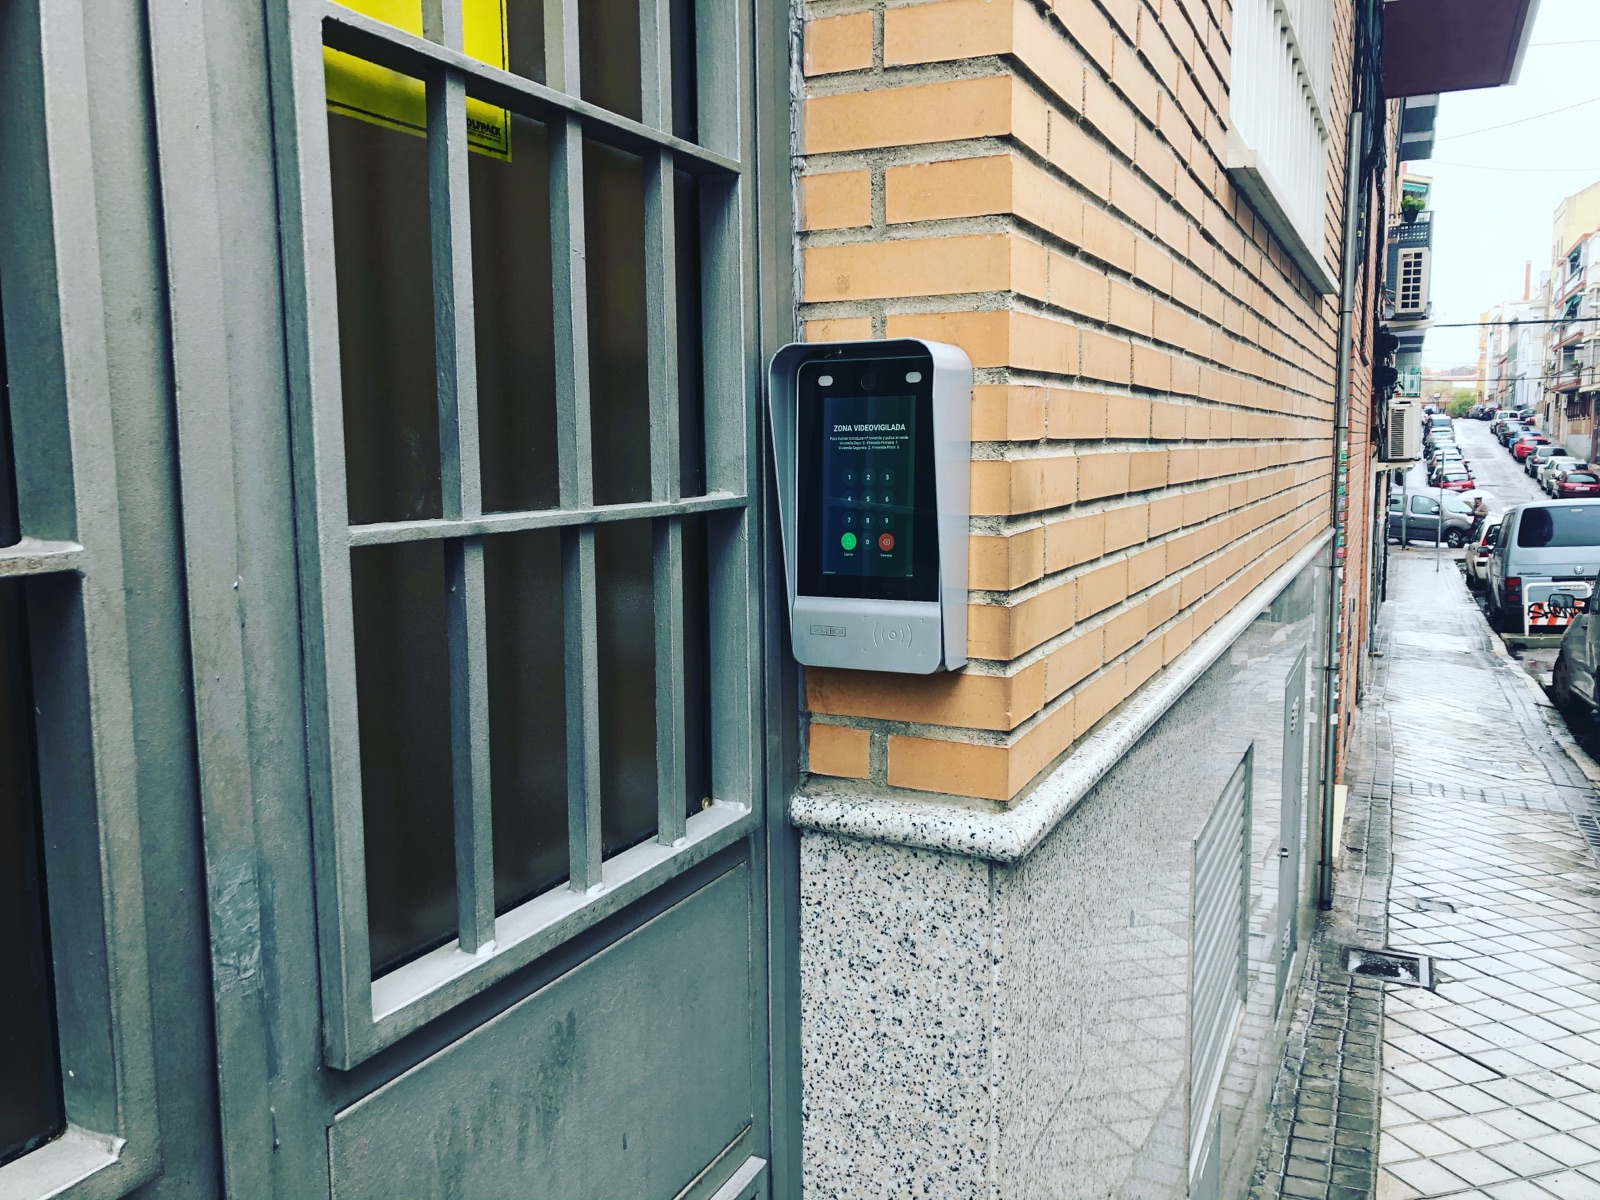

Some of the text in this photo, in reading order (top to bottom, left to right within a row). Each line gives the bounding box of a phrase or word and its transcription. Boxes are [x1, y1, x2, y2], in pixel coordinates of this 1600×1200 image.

[466, 117, 501, 137] OLFPACK
[833, 423, 906, 432] ZONA VIDEOVIGILADA
